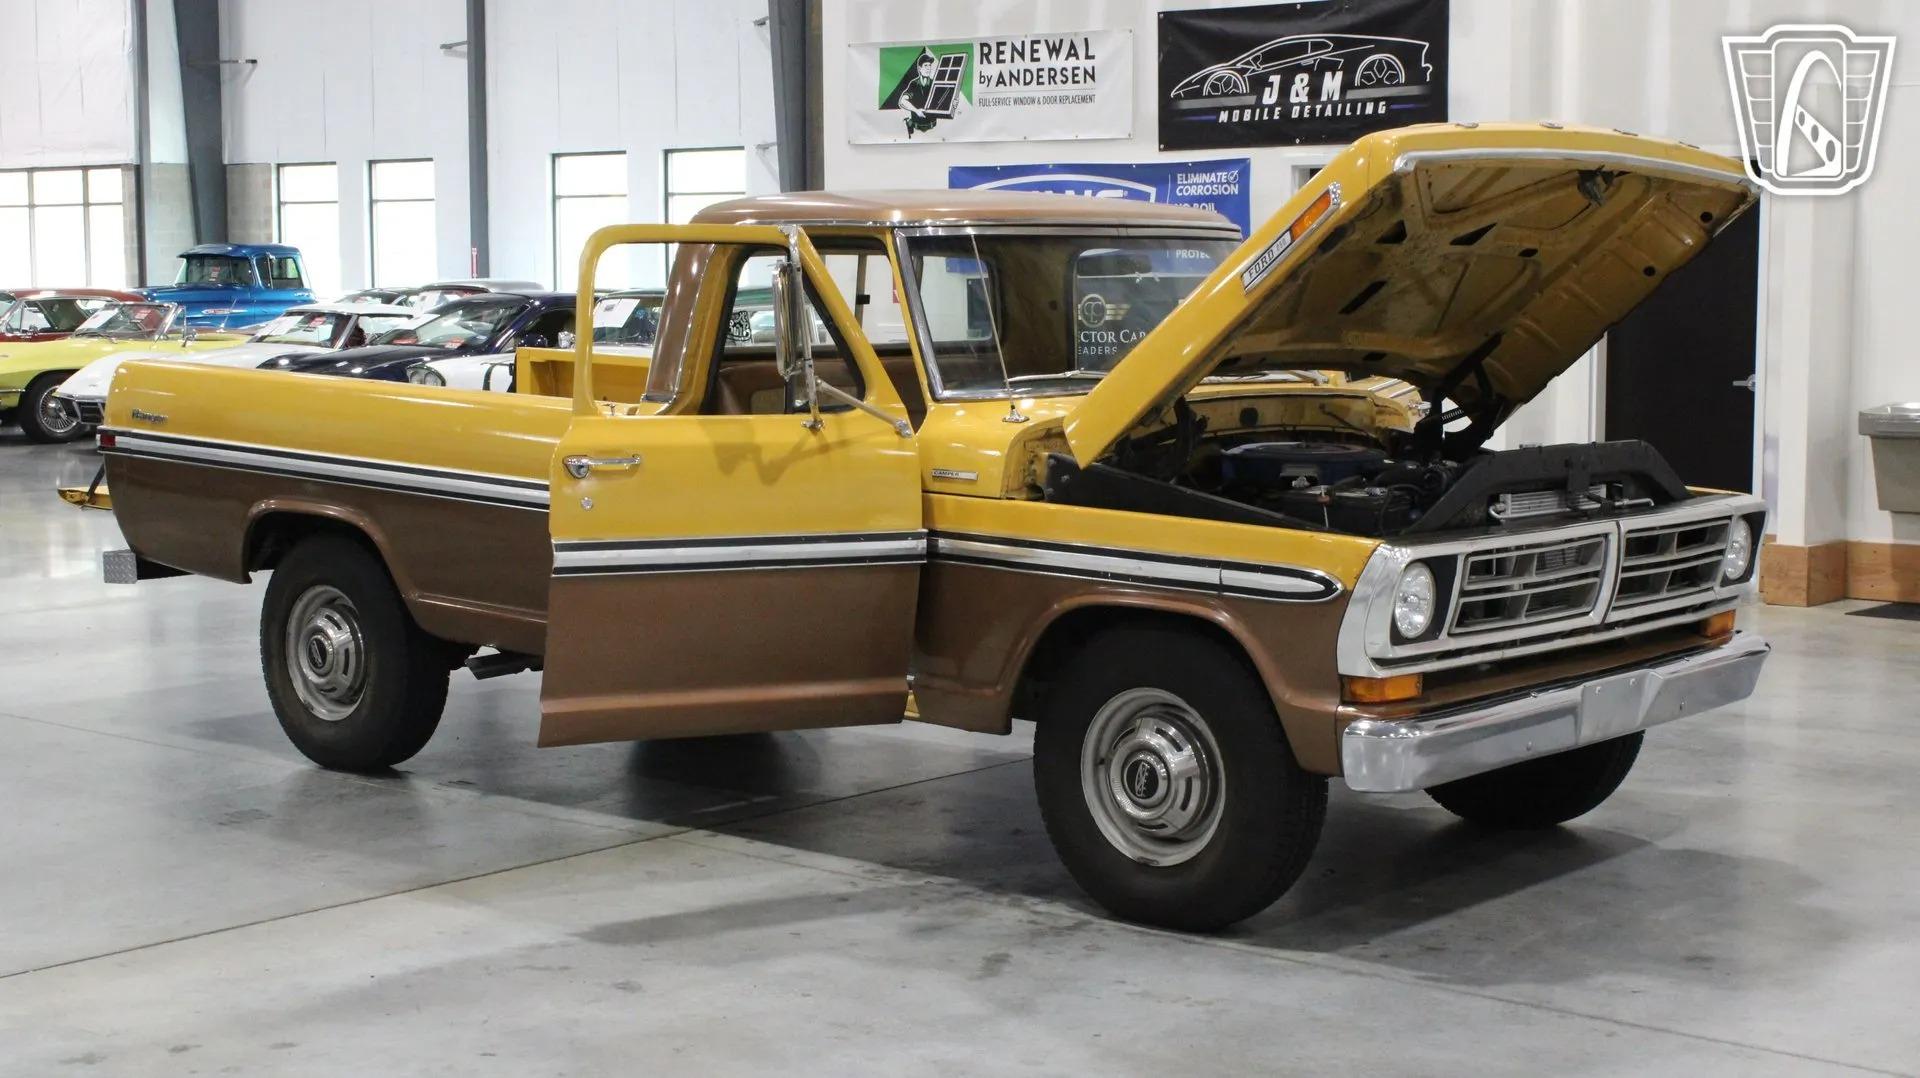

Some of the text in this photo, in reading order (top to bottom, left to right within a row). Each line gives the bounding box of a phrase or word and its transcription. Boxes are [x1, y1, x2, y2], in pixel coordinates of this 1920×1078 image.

[979, 37, 1096, 65] RENEWAL
[979, 65, 1096, 88] by ANDERSEN
[1261, 70, 1344, 105] J & M
[1013, 95, 1036, 106] WINDOW
[1042, 95, 1058, 105] DOOR
[1059, 94, 1096, 105] REPLACEMENT
[1218, 101, 1387, 123] MOBILE DETAILING
[1177, 172, 1228, 184] ELIMINATE
[1176, 185, 1239, 197] CORROSION
[1248, 249, 1275, 280] FORD
[1078, 331, 1118, 343] CTOR
